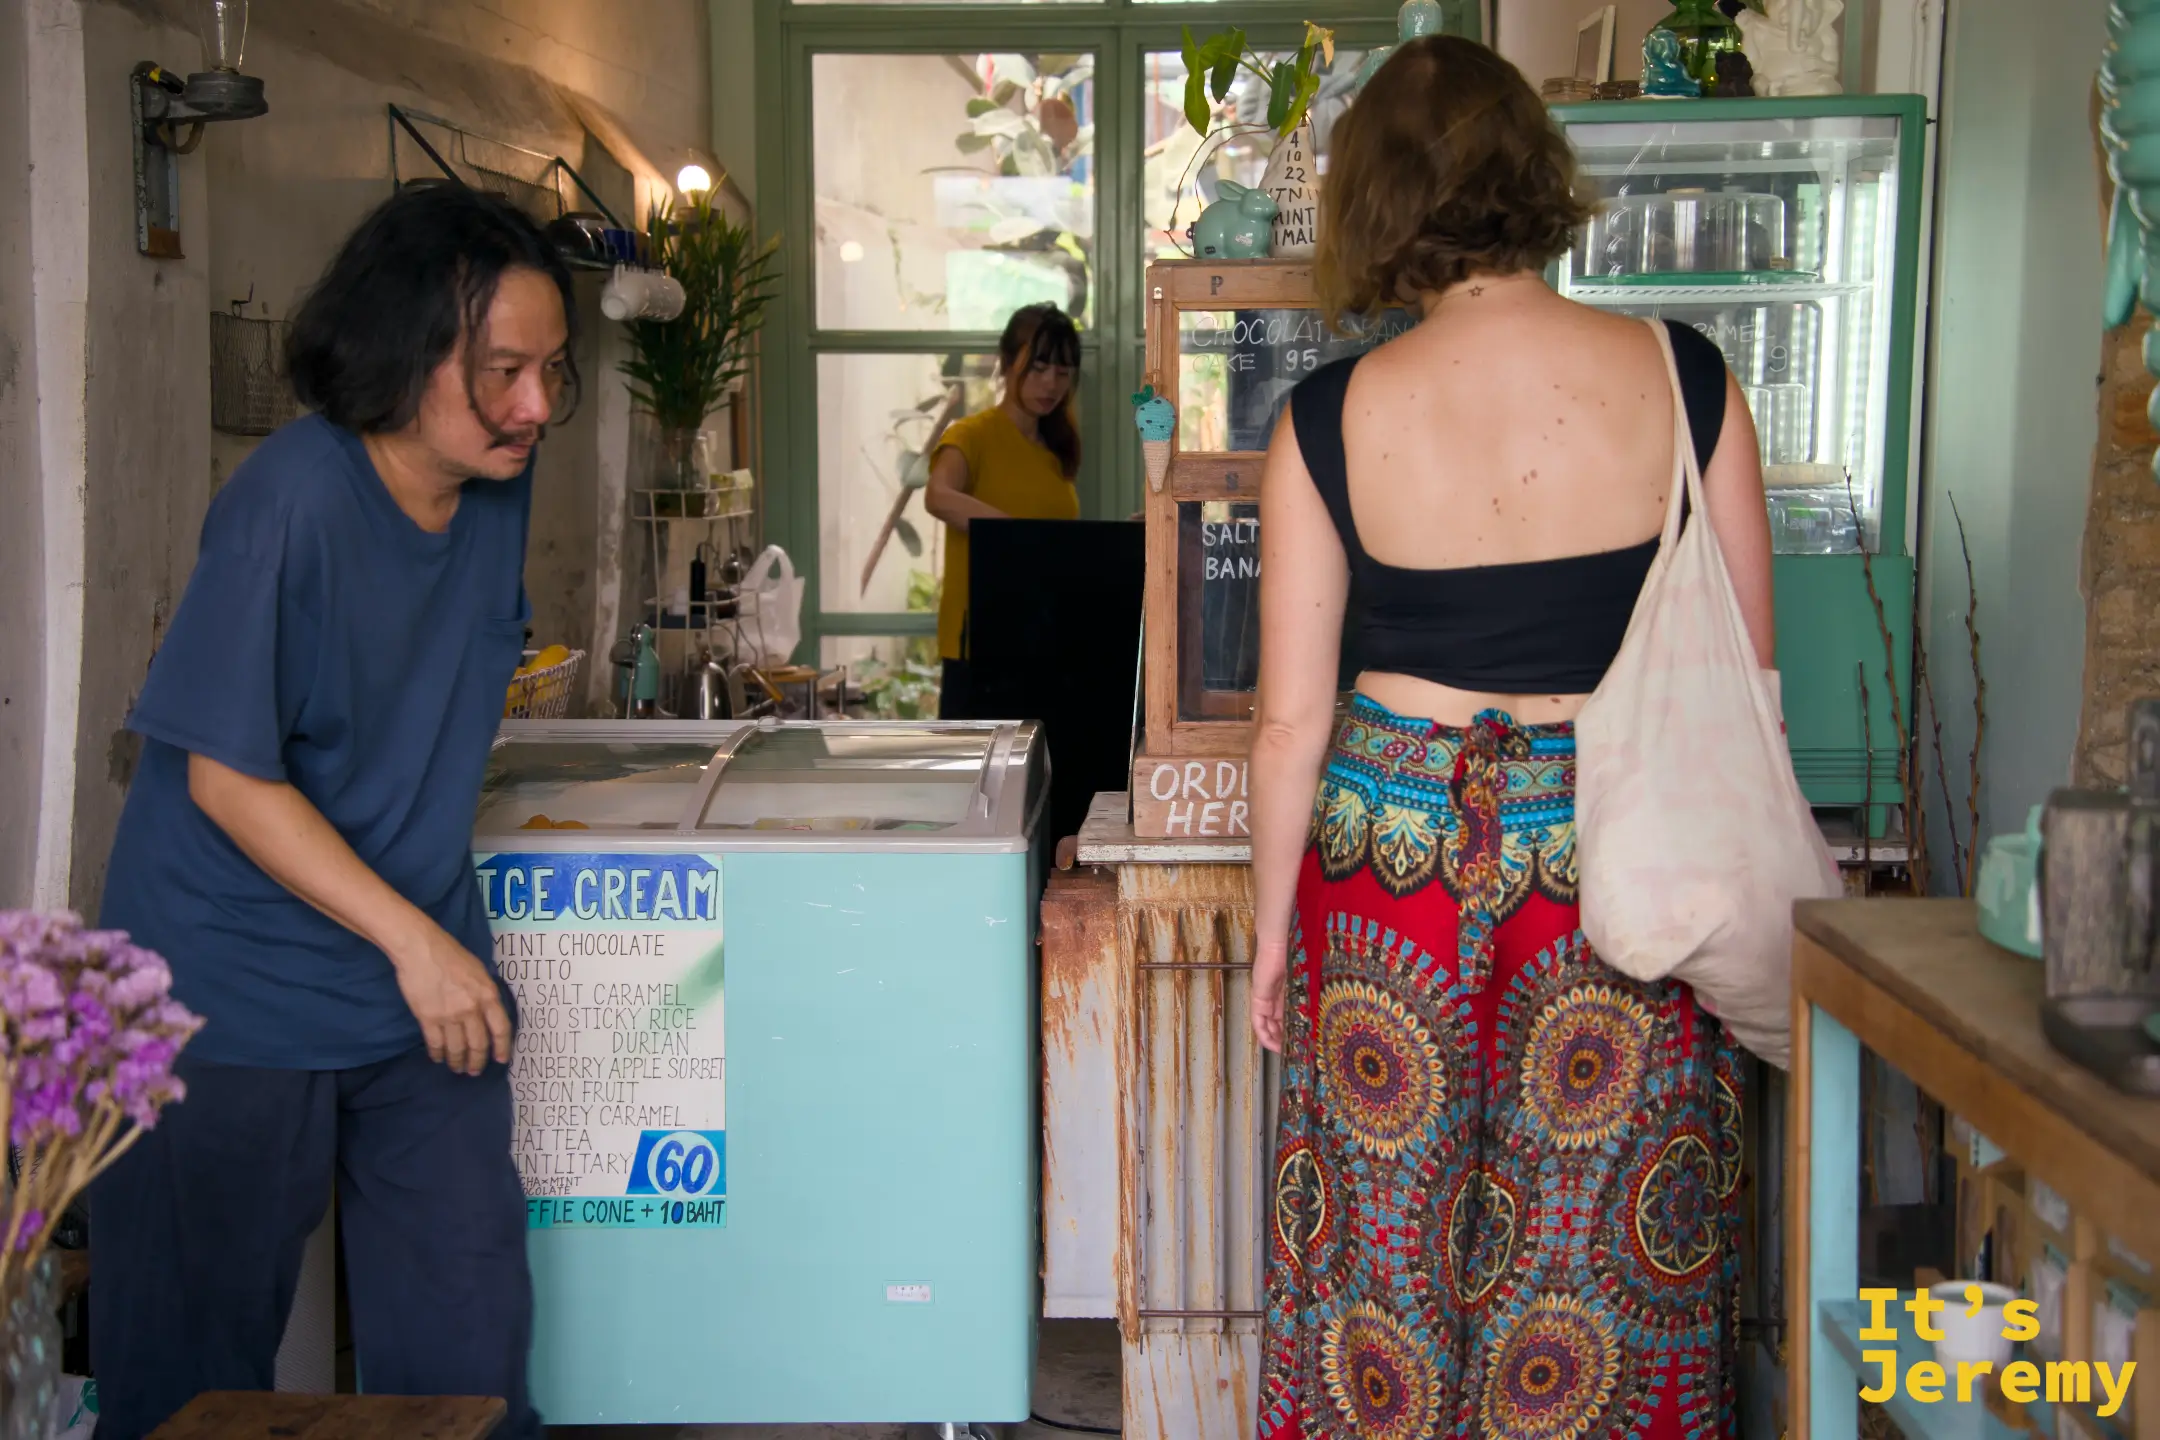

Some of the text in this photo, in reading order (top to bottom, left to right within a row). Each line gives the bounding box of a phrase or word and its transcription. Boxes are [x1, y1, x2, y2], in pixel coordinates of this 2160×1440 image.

[1290, 131, 1299, 148] 4
[1287, 151, 1302, 162] 10
[1285, 167, 1306, 183] 22
[1210, 275, 1224, 295] P
[1192, 348, 1319, 373] CAKE 95
[476, 867, 718, 921] ICE CREAM
[492, 932, 665, 957] MINT CHOCOLATE
[535, 983, 583, 1006] SALT
[593, 983, 686, 1006] CARAMEL
[516, 1006, 697, 1030] NGO STICKY RICE
[612, 1032, 689, 1055] DURIAN
[608, 1057, 662, 1080] APPLE
[667, 1057, 726, 1079] SORBET
[511, 1081, 640, 1103] SSION FRUIT
[543, 1104, 594, 1127] GREY
[599, 1105, 686, 1127] CARAMEL
[552, 1128, 593, 1151] TEA
[655, 1139, 713, 1195] 60
[582, 1200, 636, 1224] CONE
[660, 1201, 684, 1224] 10
[686, 1201, 725, 1224] BAHT
